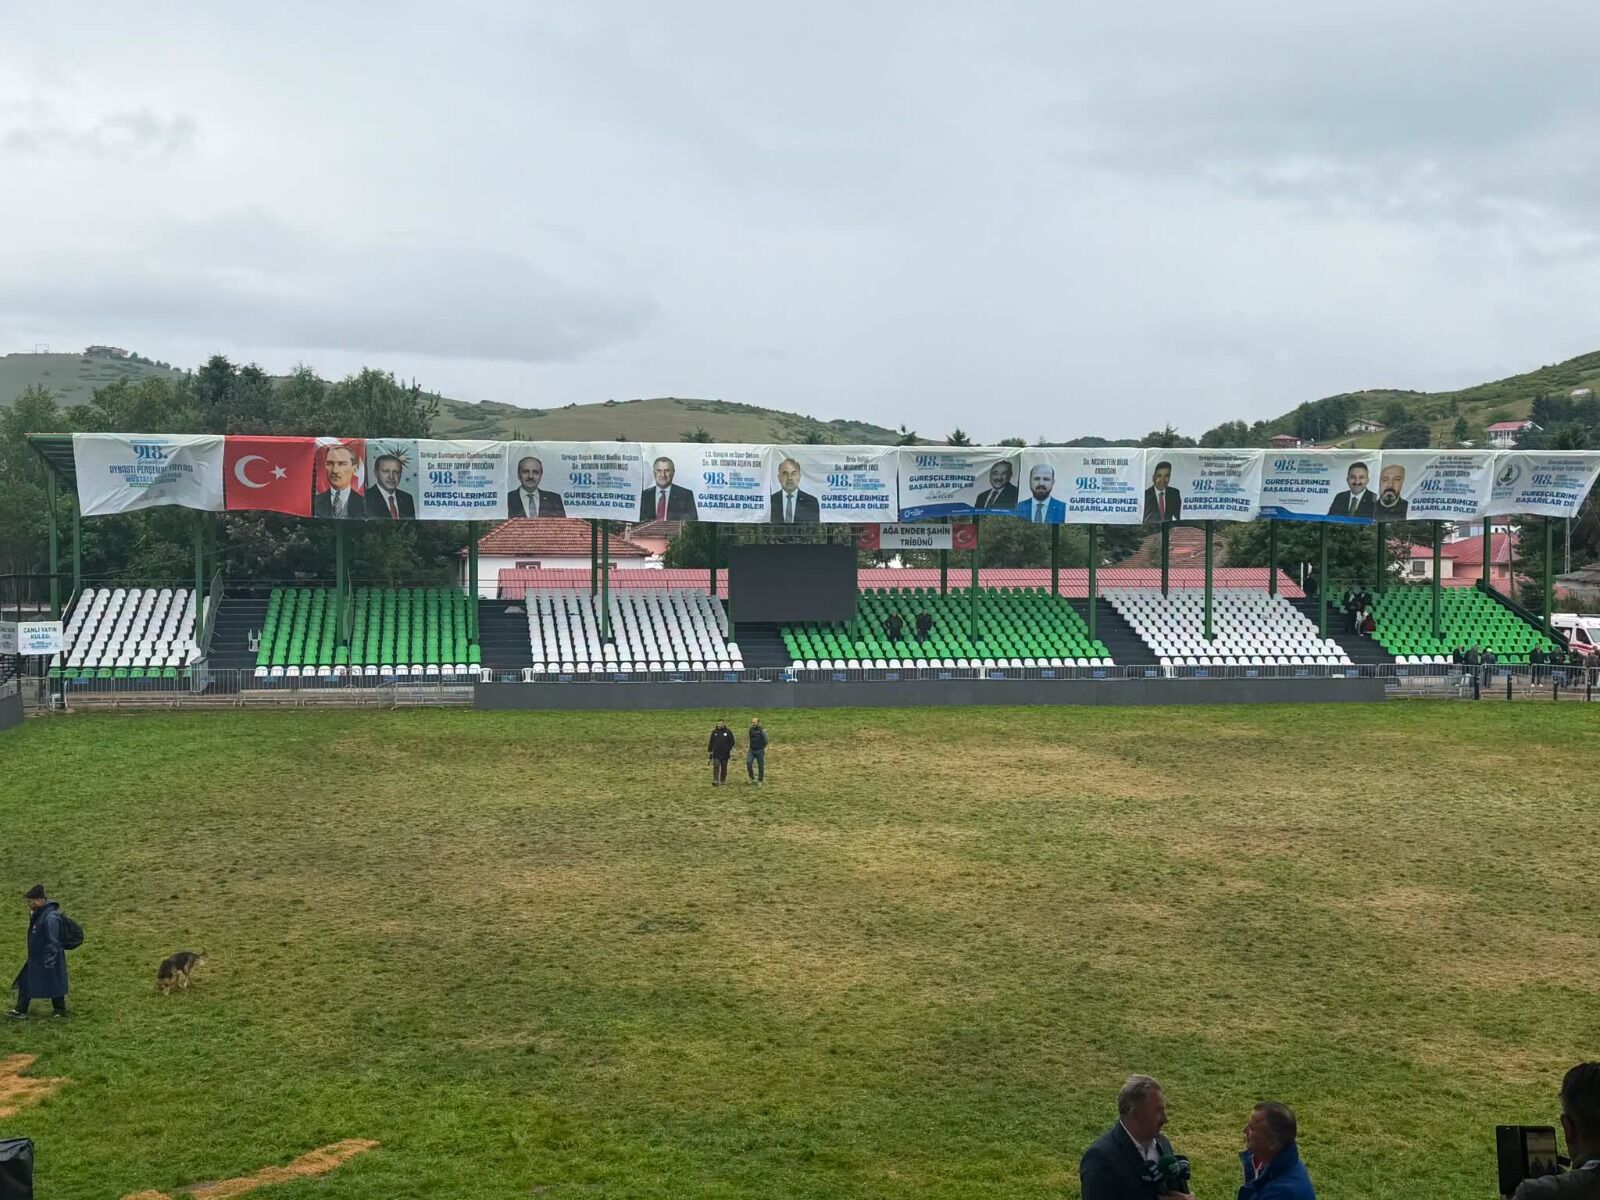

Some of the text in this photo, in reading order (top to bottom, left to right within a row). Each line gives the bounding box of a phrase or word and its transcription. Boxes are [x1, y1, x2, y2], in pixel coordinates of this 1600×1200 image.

[429, 471, 456, 484] 918.
[569, 472, 595, 485] 918.
[703, 472, 728, 485] 918.
[827, 474, 852, 487] 918.
[1076, 477, 1100, 489] 918.
[1192, 479, 1214, 491] 918.
[883, 526, 898, 534] AĞA
[927, 527, 950, 536] ŞAHİN
[900, 537, 933, 546] TRİBÜNÜ
